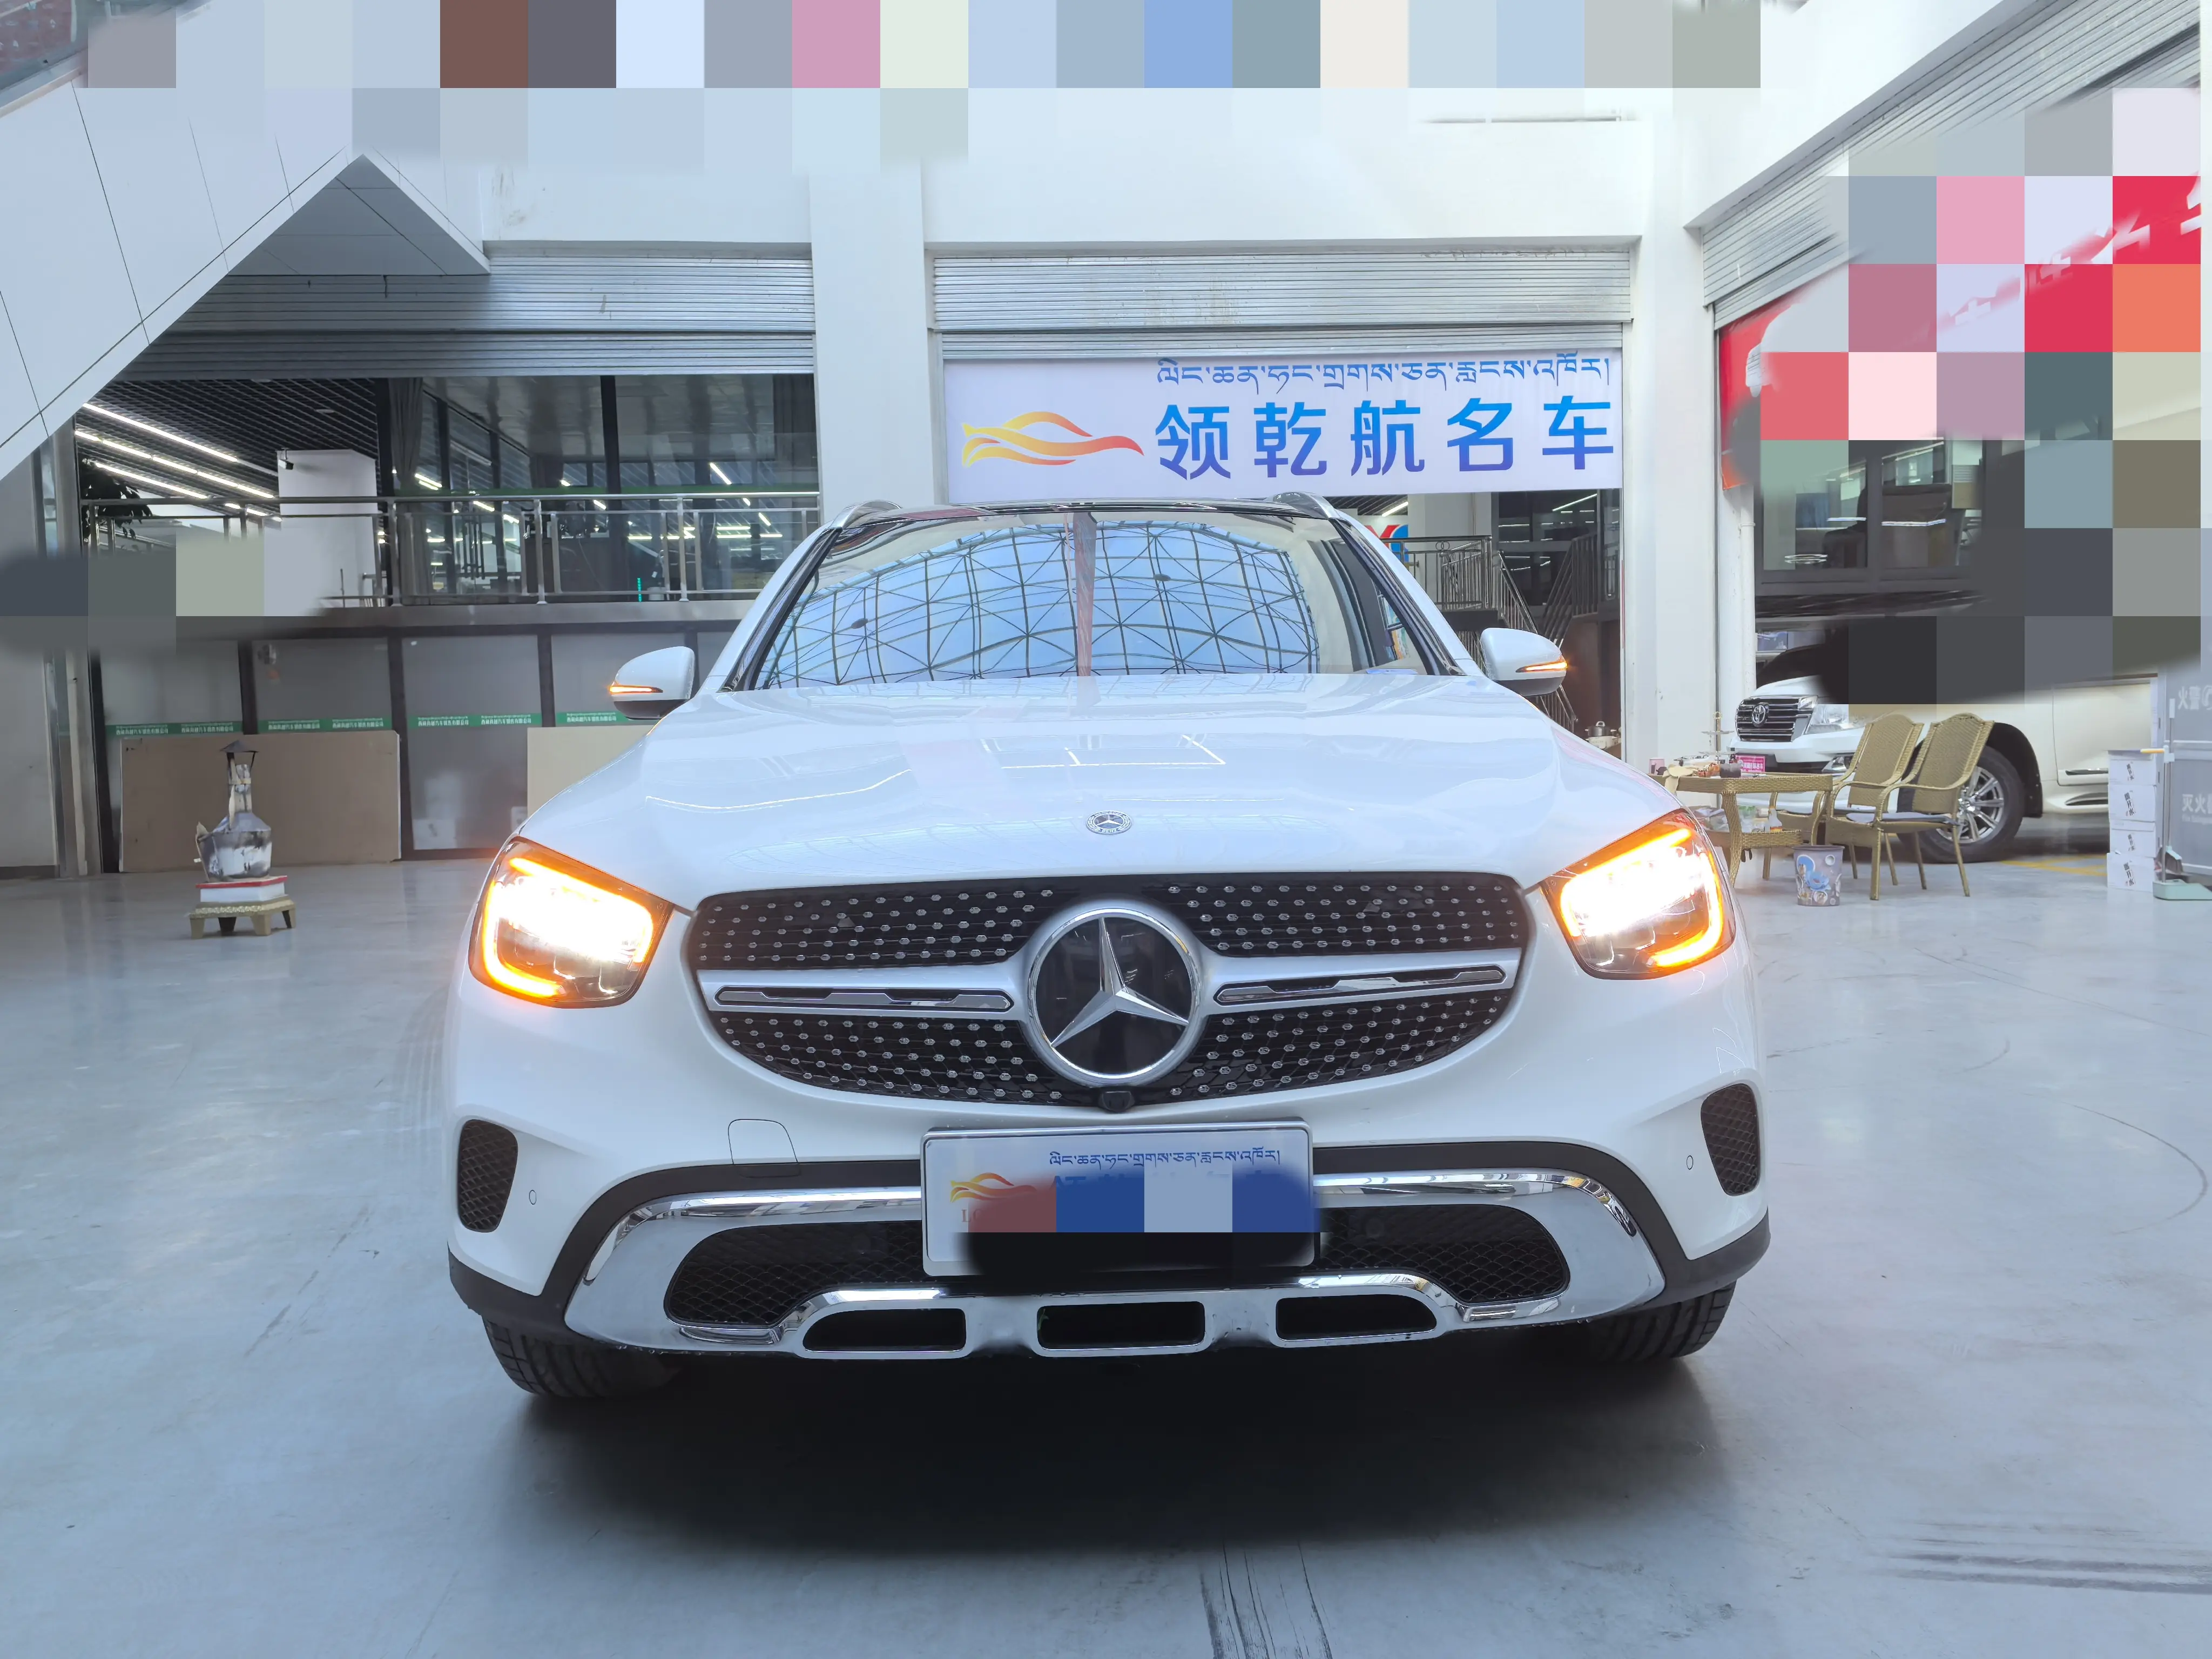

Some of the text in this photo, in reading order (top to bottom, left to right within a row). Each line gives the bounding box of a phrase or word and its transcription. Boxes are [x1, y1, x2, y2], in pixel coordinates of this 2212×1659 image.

[1155, 395, 1614, 480] 领乾航名车
[2177, 686, 2201, 710] 火警
